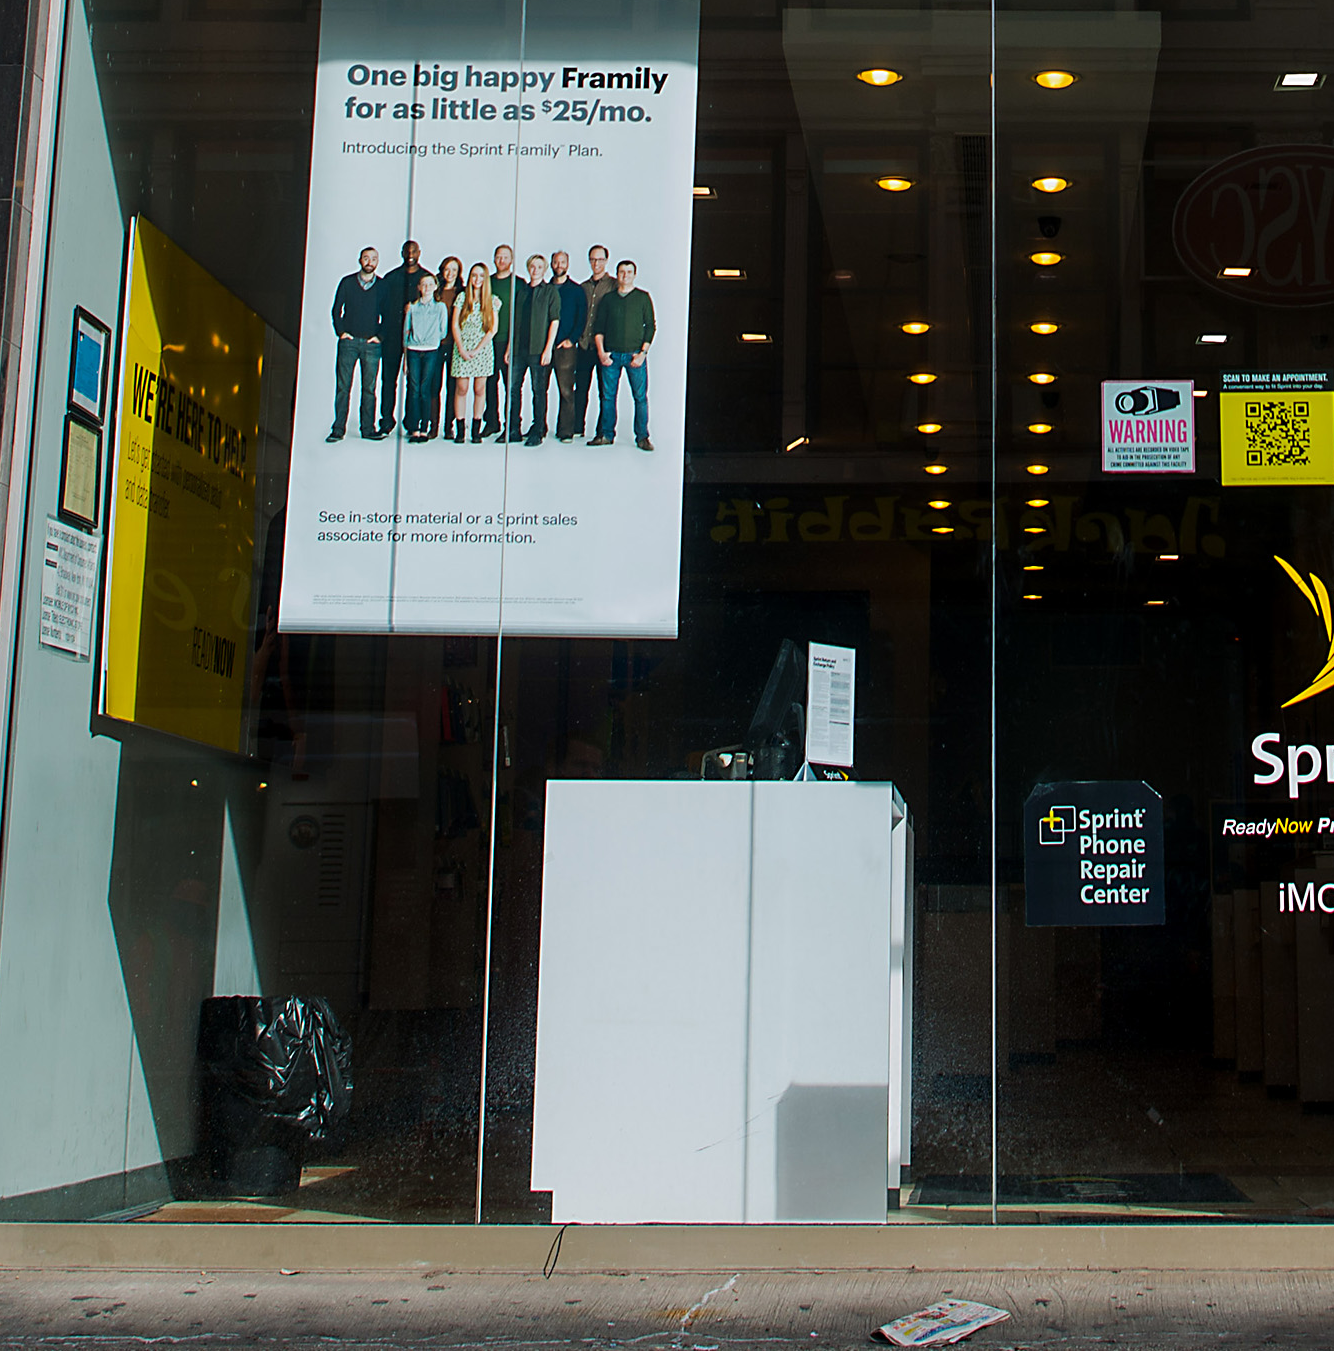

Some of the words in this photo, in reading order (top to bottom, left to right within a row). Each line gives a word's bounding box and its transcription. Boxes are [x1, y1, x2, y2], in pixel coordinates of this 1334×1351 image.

[346, 63, 407, 87] One
[413, 63, 458, 92] big
[465, 65, 555, 93] happy
[561, 66, 669, 94] Framily
[345, 96, 387, 120] for
[392, 102, 425, 121] as
[431, 97, 497, 121] little
[502, 103, 535, 121] as
[541, 99, 652, 125] $25/mo.
[341, 141, 428, 158] Introducing
[431, 142, 456, 156] the
[459, 142, 503, 159] Sprint
[569, 144, 603, 158] Plan.
[1222, 373, 1240, 383] SCAN
[1241, 373, 1250, 382] TO
[1252, 373, 1270, 382] MAKE
[1271, 373, 1281, 382] AN
[1282, 372, 1329, 382] APPOINTMENT.
[176, 391, 205, 453] HERE
[208, 412, 222, 465] TO
[1108, 419, 1187, 443] WARNING
[318, 511, 346, 524] See
[349, 511, 402, 525] in-store
[405, 512, 463, 525] material
[466, 515, 481, 525] or
[485, 516, 493, 525] a
[497, 513, 539, 528] Sprint
[542, 513, 578, 526] sales
[317, 530, 383, 543] associate
[386, 529, 407, 543] for
[410, 532, 448, 543] more
[451, 531, 537, 544] information.
[1222, 817, 1313, 838] ReadyNow
[1079, 834, 1146, 856] Phone
[1079, 859, 1147, 883] Repair
[1079, 884, 1151, 905] Center
